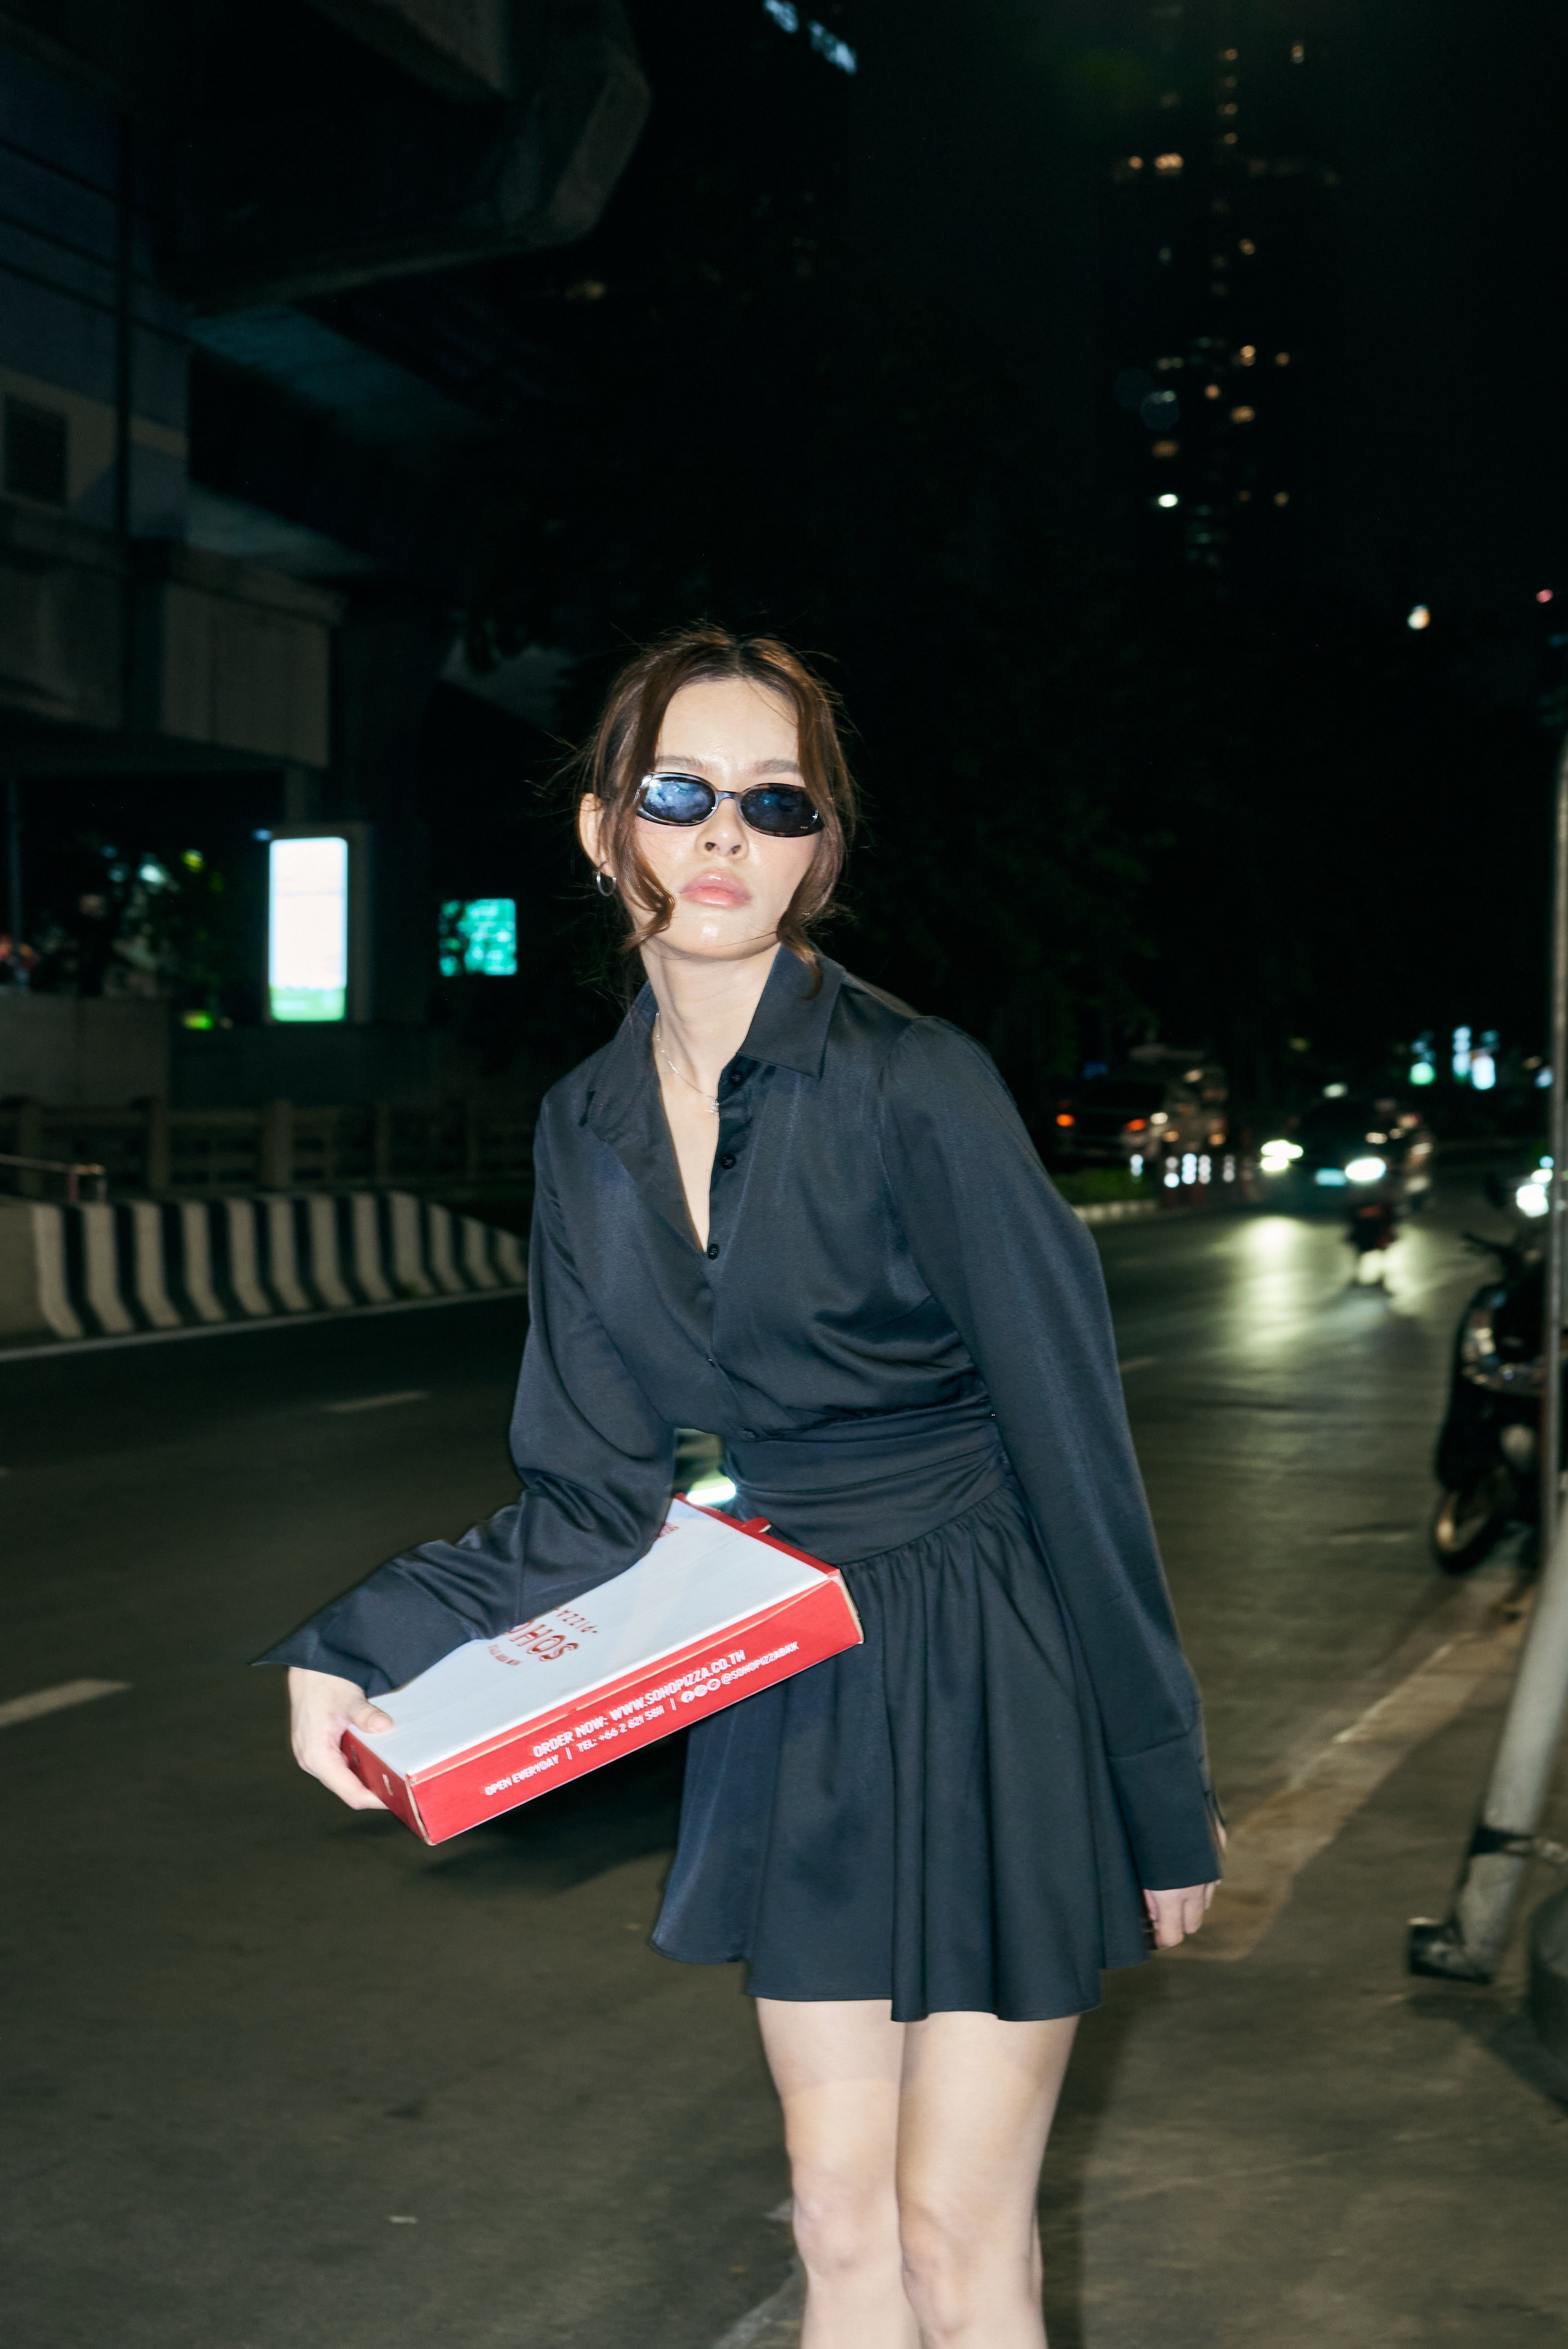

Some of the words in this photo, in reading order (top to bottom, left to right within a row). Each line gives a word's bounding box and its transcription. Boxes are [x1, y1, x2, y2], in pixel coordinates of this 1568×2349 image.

[484, 1777, 513, 1796] OPEN
[511, 1754, 559, 1784] EVERYDAY
[576, 1738, 598, 1752] TEL:
[598, 1727, 619, 1741] +66
[619, 1723, 627, 1733] 2
[627, 1715, 644, 1729] 821
[721, 1641, 800, 1685] @SOHOPIZZABKK
[533, 1732, 575, 1757] ORDER
[575, 1716, 609, 1738] NOW:
[609, 1649, 746, 1721] WWW.SOHOPIZZA.CO.TH
